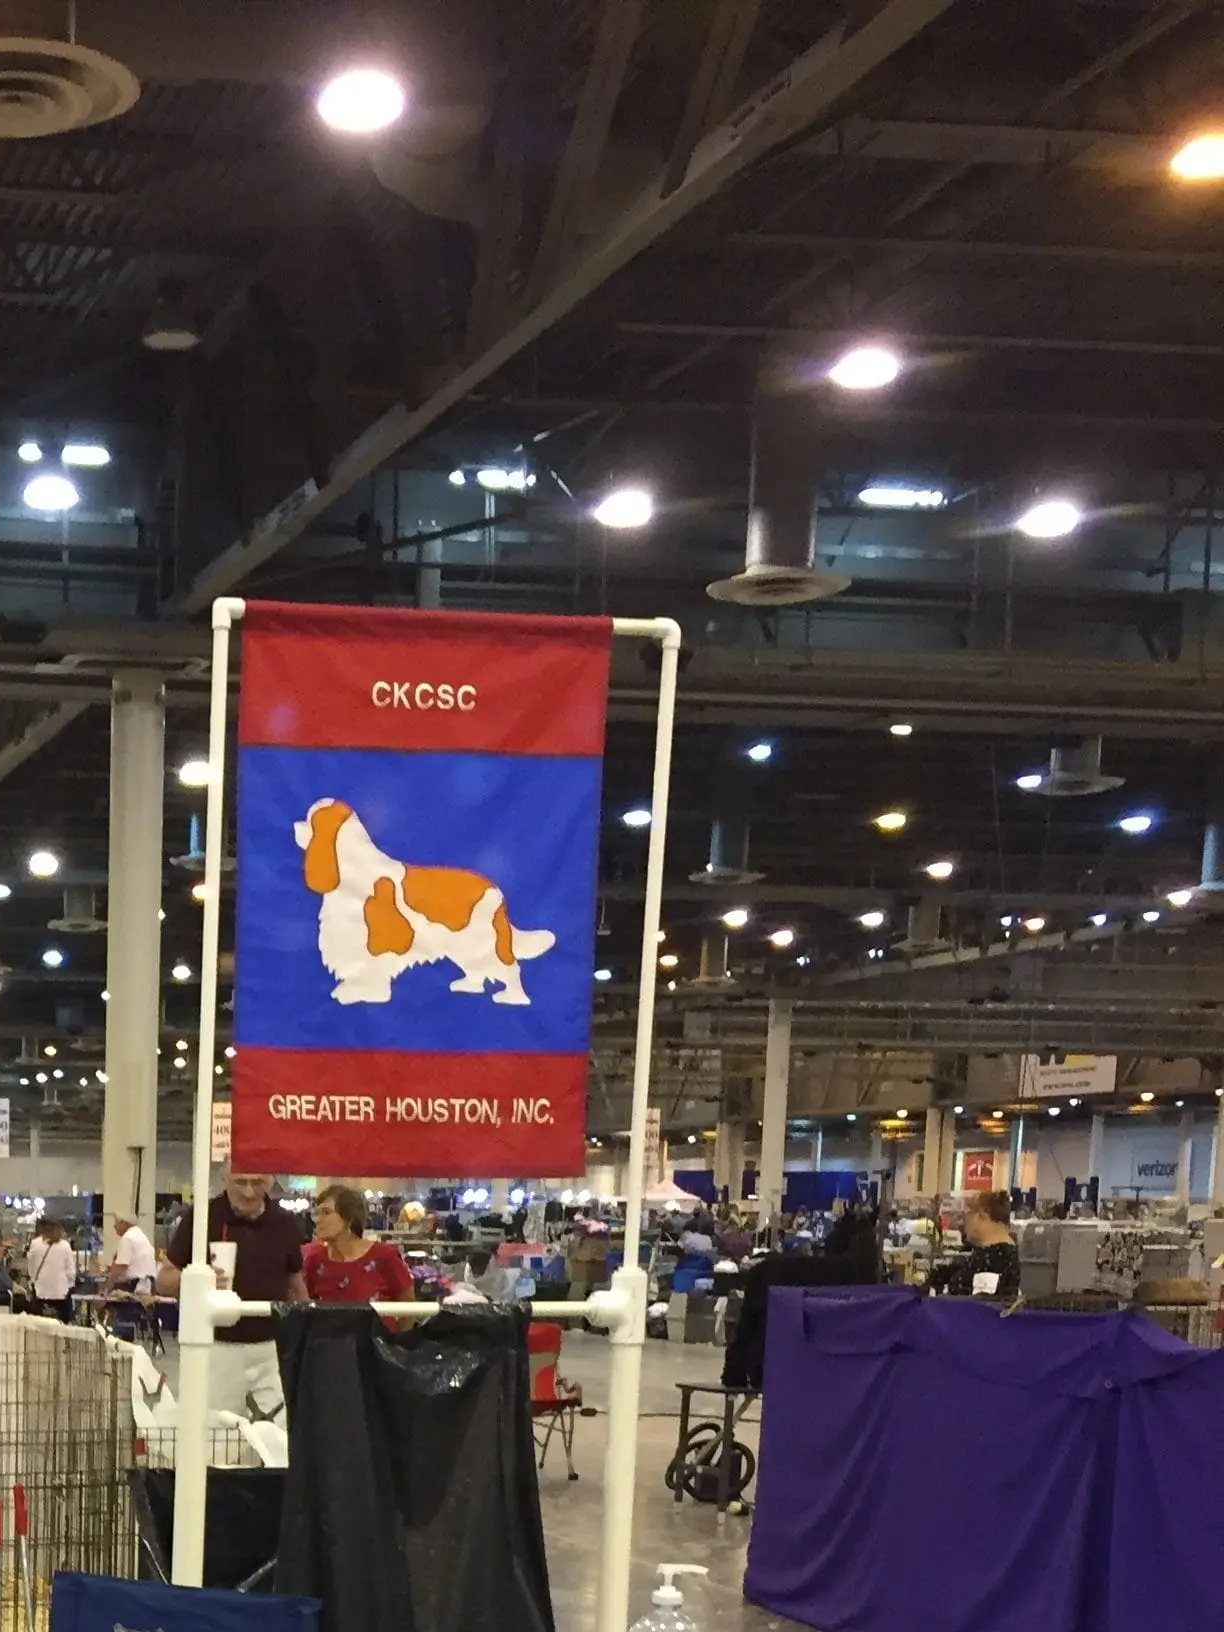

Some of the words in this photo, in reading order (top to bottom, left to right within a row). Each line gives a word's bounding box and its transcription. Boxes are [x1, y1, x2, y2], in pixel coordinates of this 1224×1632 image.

[371, 680, 477, 711] CKCSC
[268, 1094, 374, 1122] GREATER
[385, 1096, 501, 1128] HOUSTON,
[511, 1097, 554, 1125] INC.
